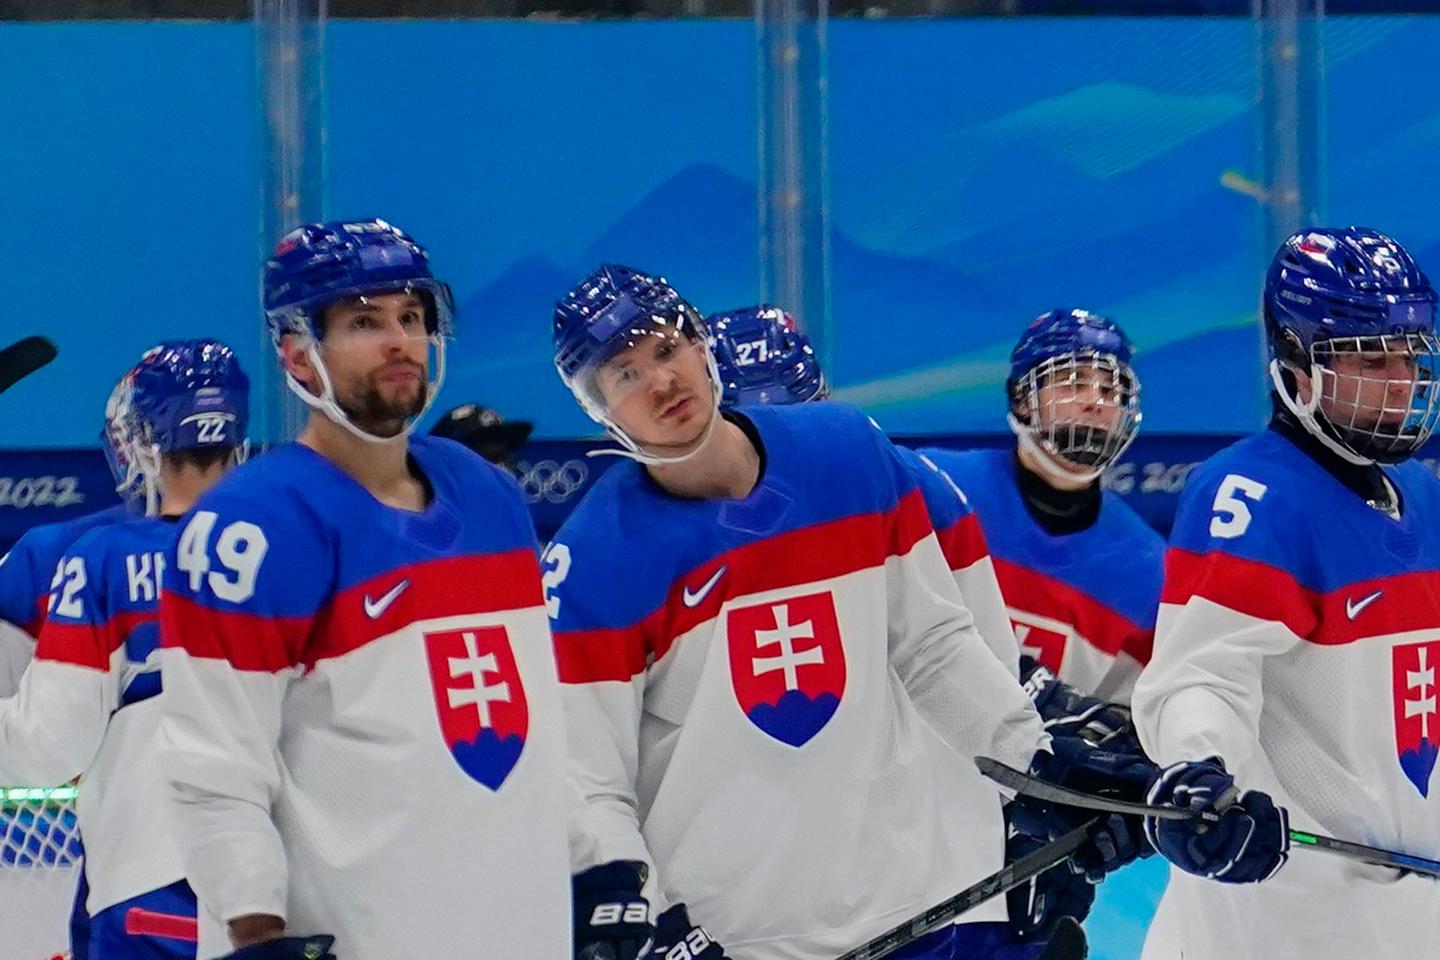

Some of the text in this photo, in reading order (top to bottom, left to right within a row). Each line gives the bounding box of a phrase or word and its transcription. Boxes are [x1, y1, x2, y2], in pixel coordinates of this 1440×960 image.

[736, 339, 768, 366] 27
[197, 418, 226, 443] 22
[1210, 474, 1268, 538] 5
[177, 511, 269, 604] 49
